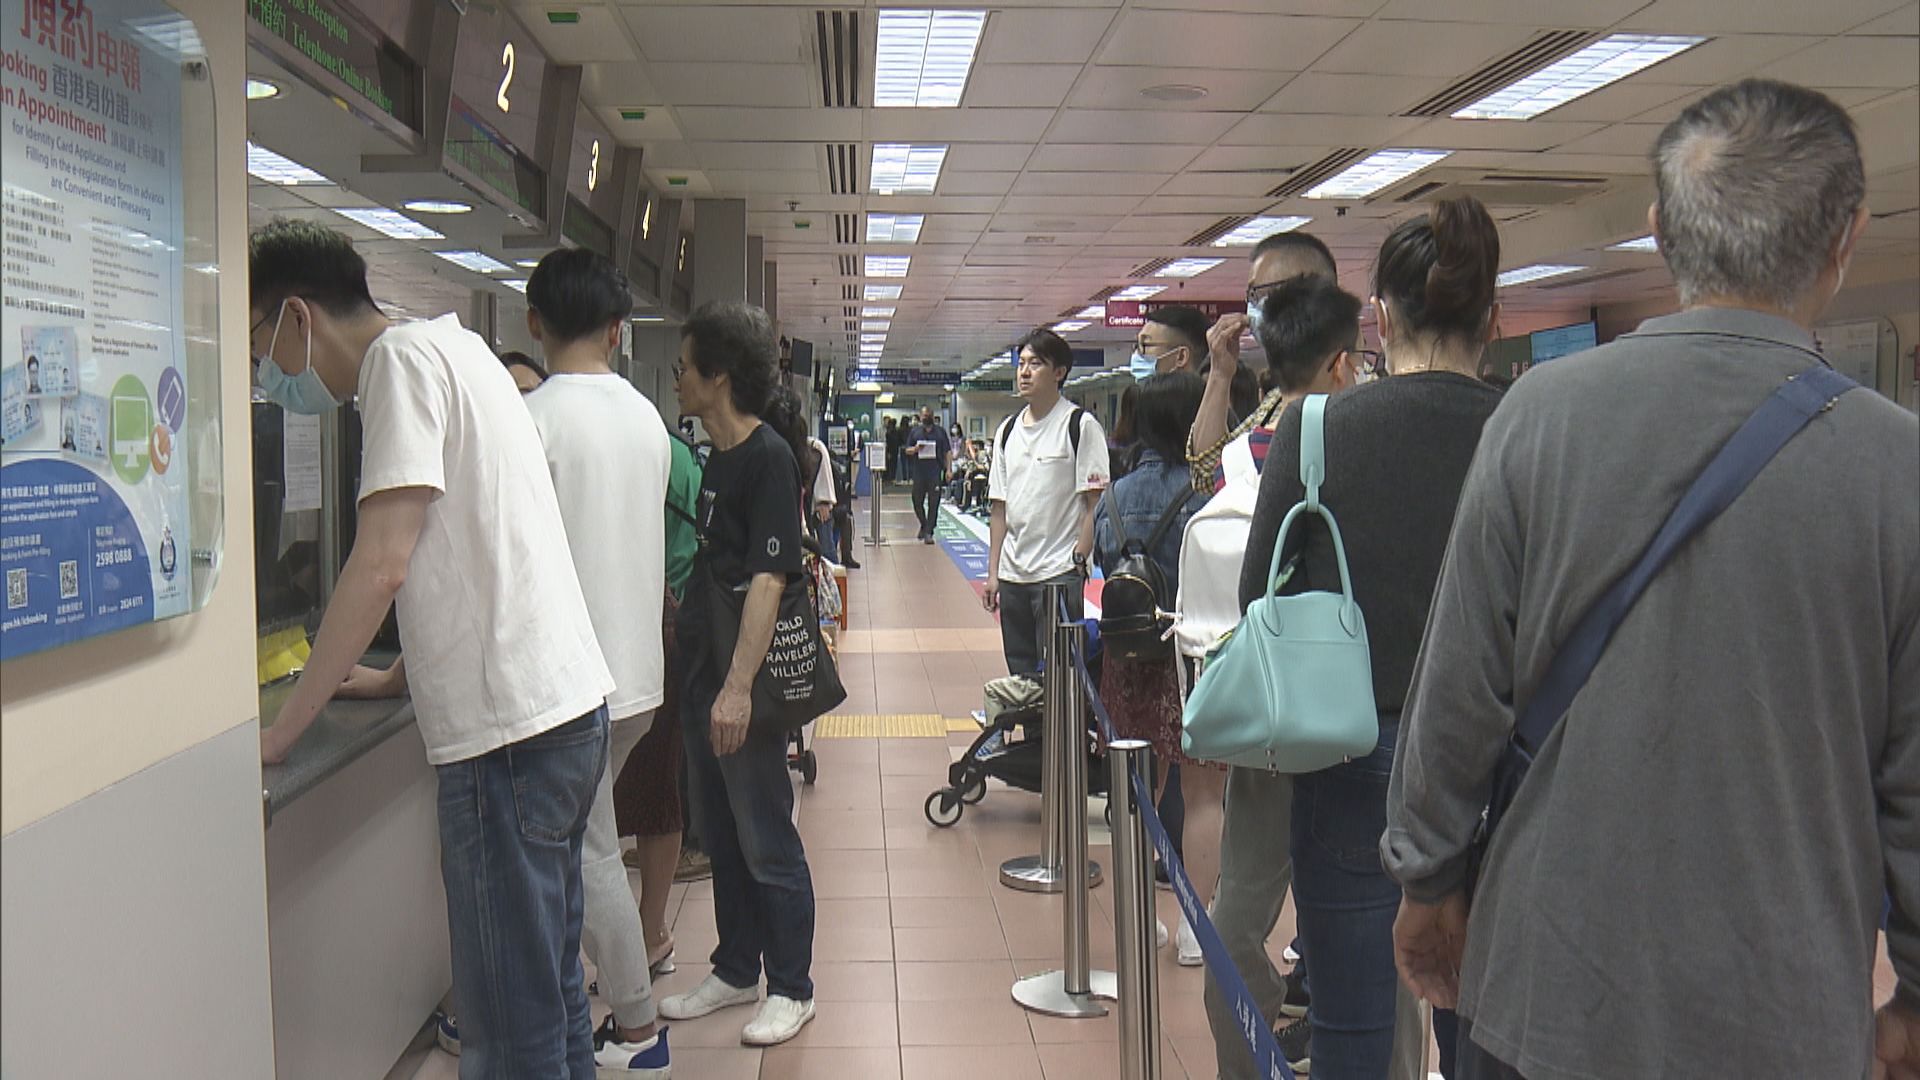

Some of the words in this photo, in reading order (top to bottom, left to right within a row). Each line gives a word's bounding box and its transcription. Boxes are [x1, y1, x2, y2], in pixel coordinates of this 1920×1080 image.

[52, 63, 130, 126] 香港身份證
[497, 42, 515, 113] 2
[18, 87, 107, 144] Appointment
[12, 118, 24, 135] for
[26, 123, 54, 149] Identity
[56, 136, 74, 154] Card
[74, 144, 113, 170] Application
[26, 146, 49, 169] Filling
[59, 158, 71, 174] the
[588, 139, 599, 192] 3
[64, 178, 103, 202] Convenient
[642, 200, 651, 240] 4
[1109, 315, 1144, 326] Certificate
[773, 628, 809, 648] AMOUS
[776, 616, 803, 631] ORLD
[766, 640, 817, 663] RAVELER
